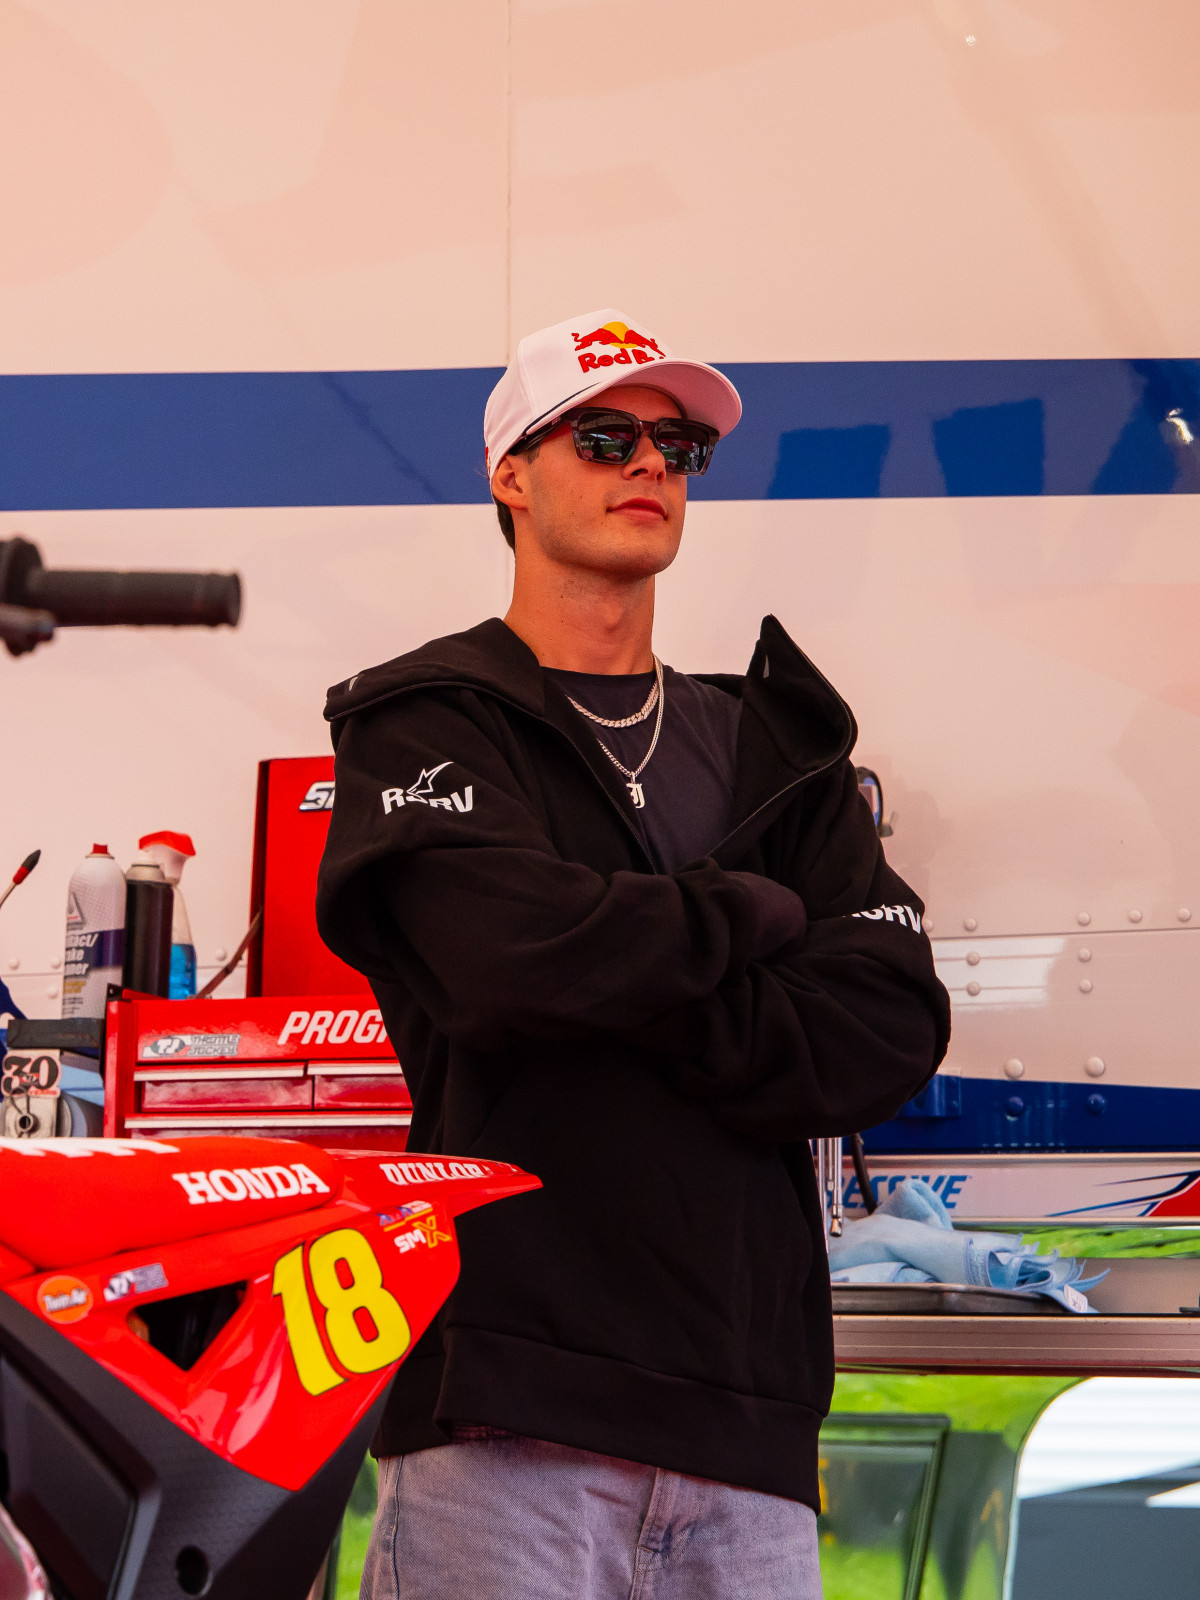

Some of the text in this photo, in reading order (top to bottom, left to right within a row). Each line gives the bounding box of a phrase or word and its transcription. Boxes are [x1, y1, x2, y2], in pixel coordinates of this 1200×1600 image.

[578, 348, 632, 373] Red
[299, 779, 336, 812] S
[851, 903, 921, 934] SRV
[3, 1055, 59, 1095] 30
[172, 1163, 331, 1205] HONDA
[379, 1162, 488, 1186] DUNLOP
[393, 1215, 453, 1254] SMX
[272, 1227, 413, 1397] 18
